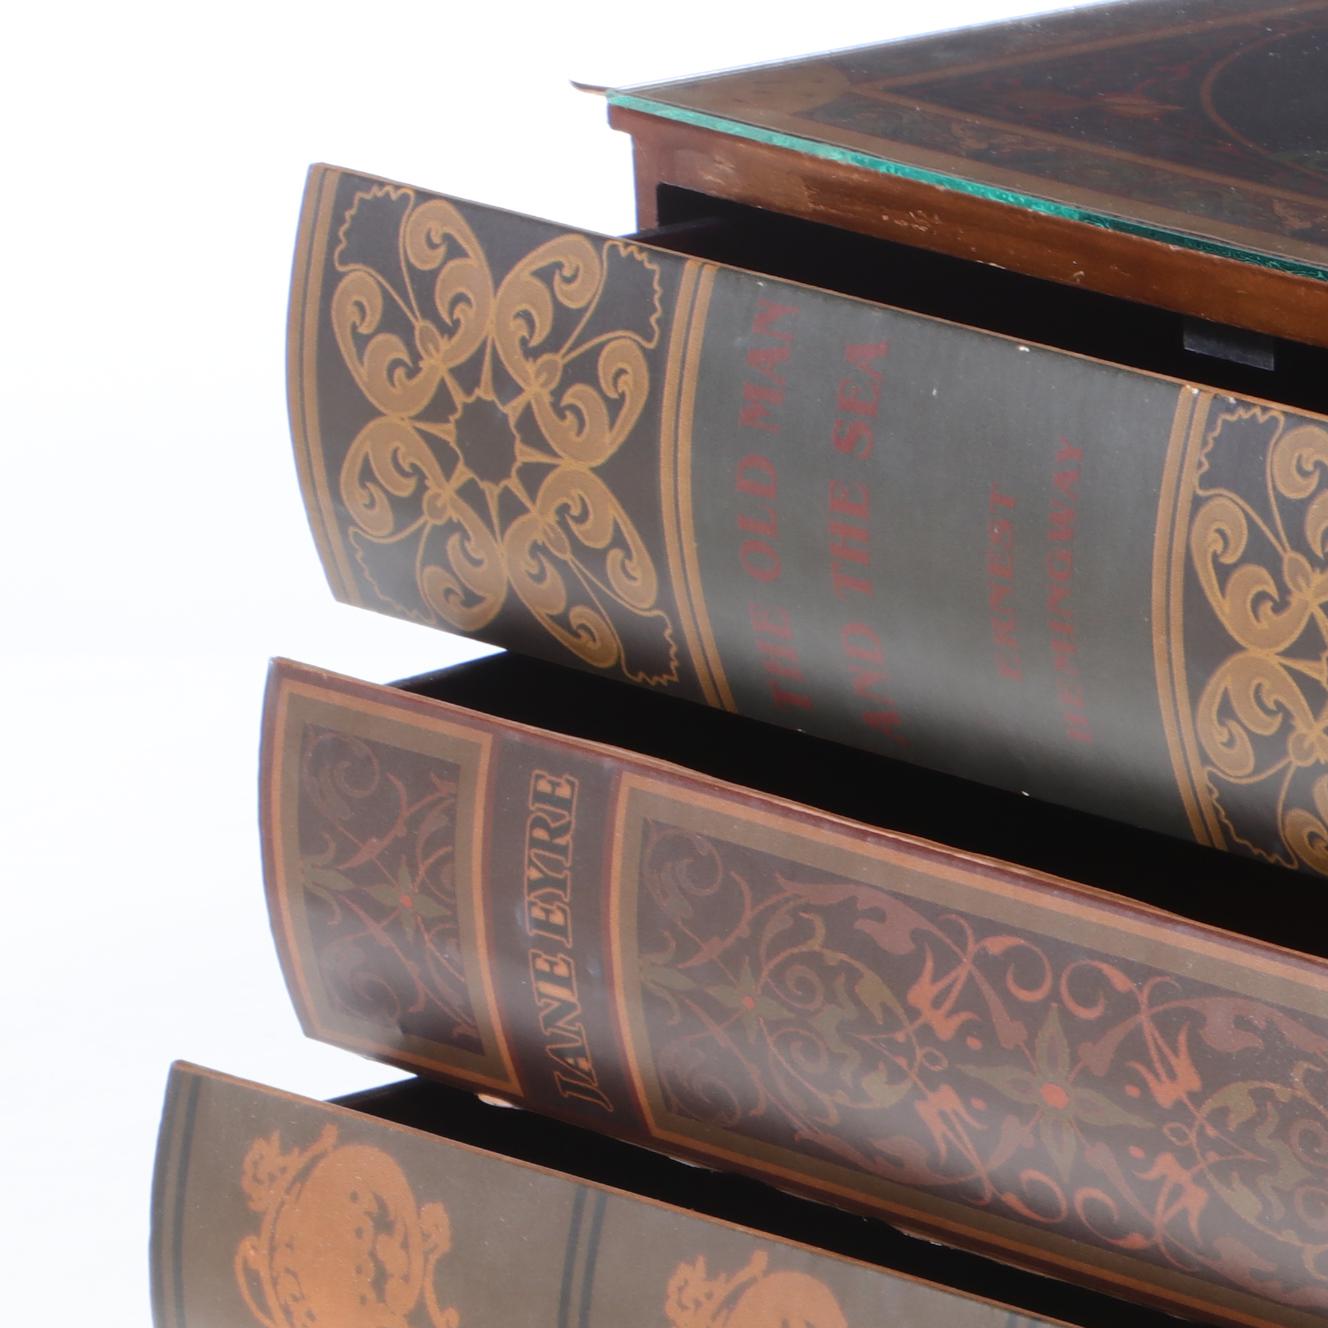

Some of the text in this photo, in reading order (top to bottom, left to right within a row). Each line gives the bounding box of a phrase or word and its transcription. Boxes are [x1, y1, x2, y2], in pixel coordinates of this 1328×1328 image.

[736, 298, 813, 713] THE OLD MAN
[829, 340, 911, 746] AND THE SEA
[987, 482, 1023, 682] ERNEST
[1047, 436, 1093, 743] HEMINGWAY
[524, 769, 613, 1112] JANE EYRE
